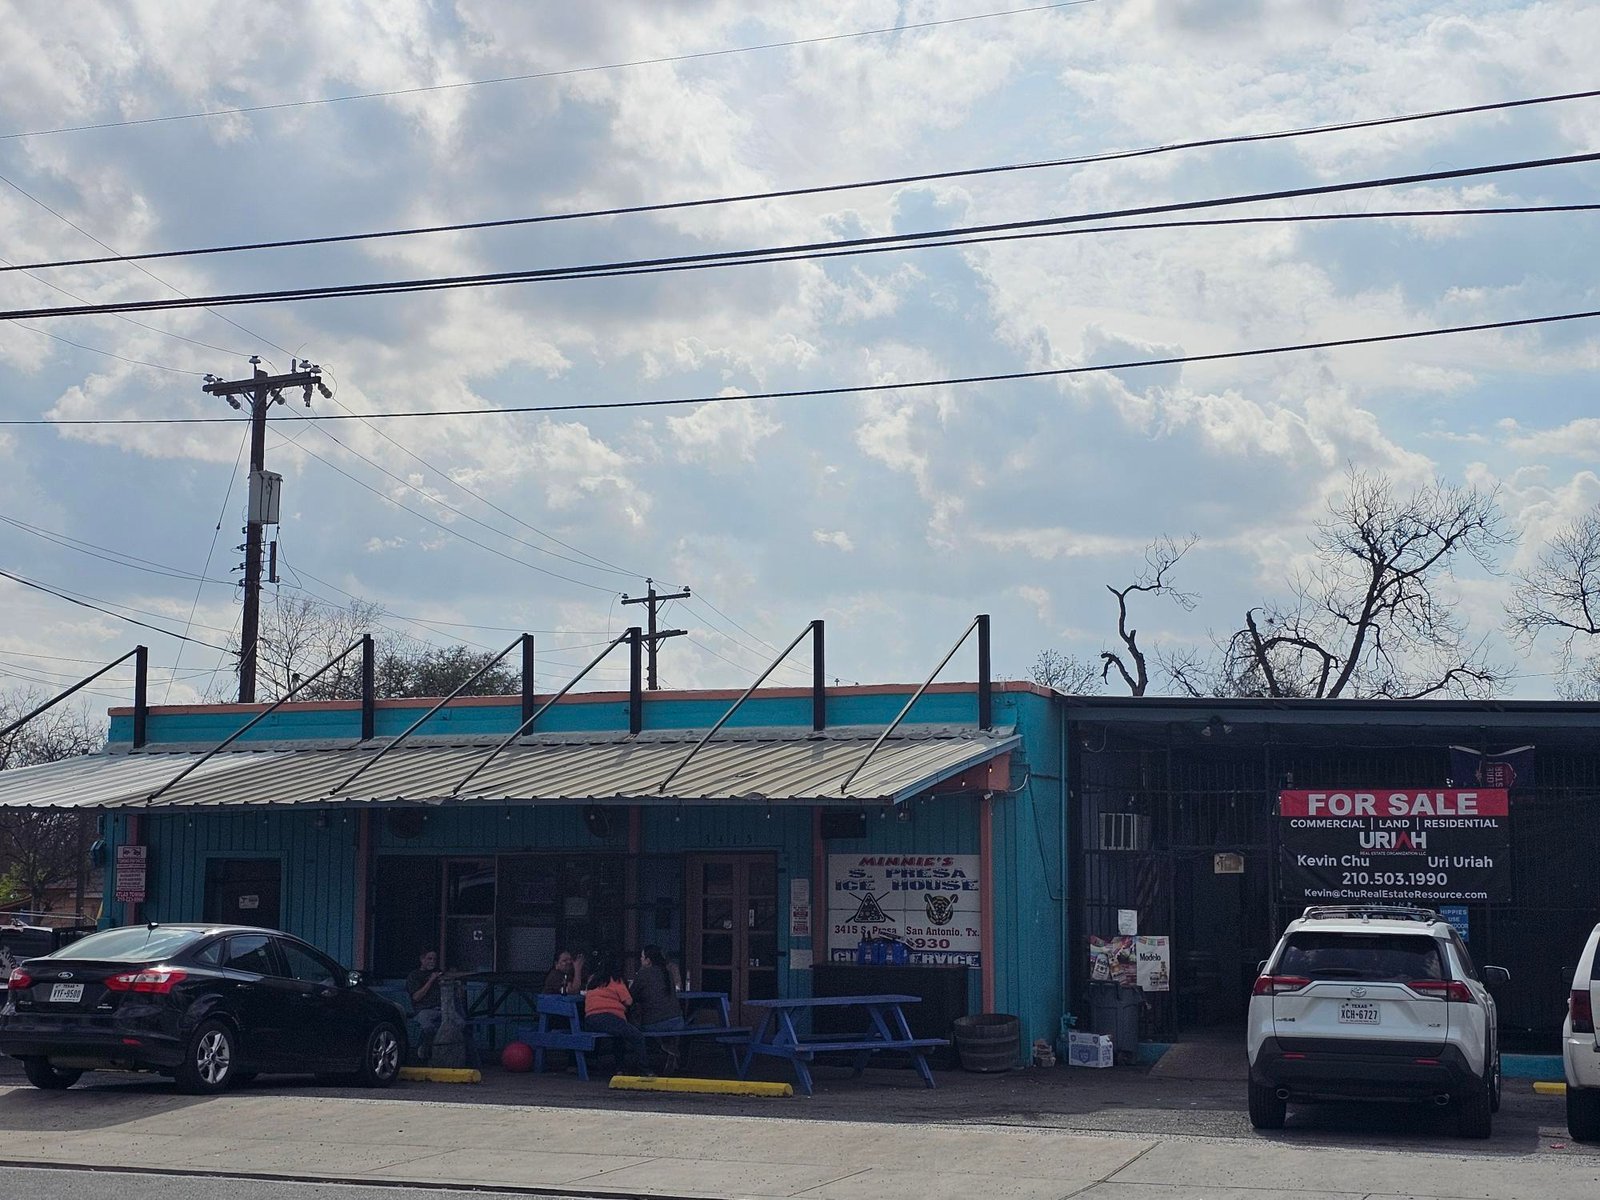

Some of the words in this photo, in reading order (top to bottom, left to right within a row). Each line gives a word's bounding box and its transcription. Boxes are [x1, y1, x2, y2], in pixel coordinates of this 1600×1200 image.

[1308, 793, 1376, 816] FOR
[1388, 793, 1478, 816] SALE
[1290, 819, 1366, 829] COMMERCIAL
[1379, 819, 1410, 829] LAND
[1424, 818, 1499, 828] RESIDENTIAL
[858, 856, 955, 867] MINNIE'S
[1297, 855, 1337, 867] Kevin
[1341, 855, 1370, 867] Chu
[1428, 856, 1449, 868] Uri
[1453, 856, 1493, 868] Uriah
[849, 868, 873, 879] S.
[885, 868, 966, 879] PRESA
[1342, 872, 1448, 886] 210.503.1990
[835, 880, 876, 891] ICE
[891, 880, 979, 891] HOUSE
[1304, 889, 1488, 900] Kevin@ChuRealEstateResource.com
[834, 925, 858, 935] 3415
[906, 926, 924, 936] San
[966, 927, 980, 937] Tx.
[908, 951, 980, 967] ERVICE
[1139, 952, 1162, 962] Modelo
